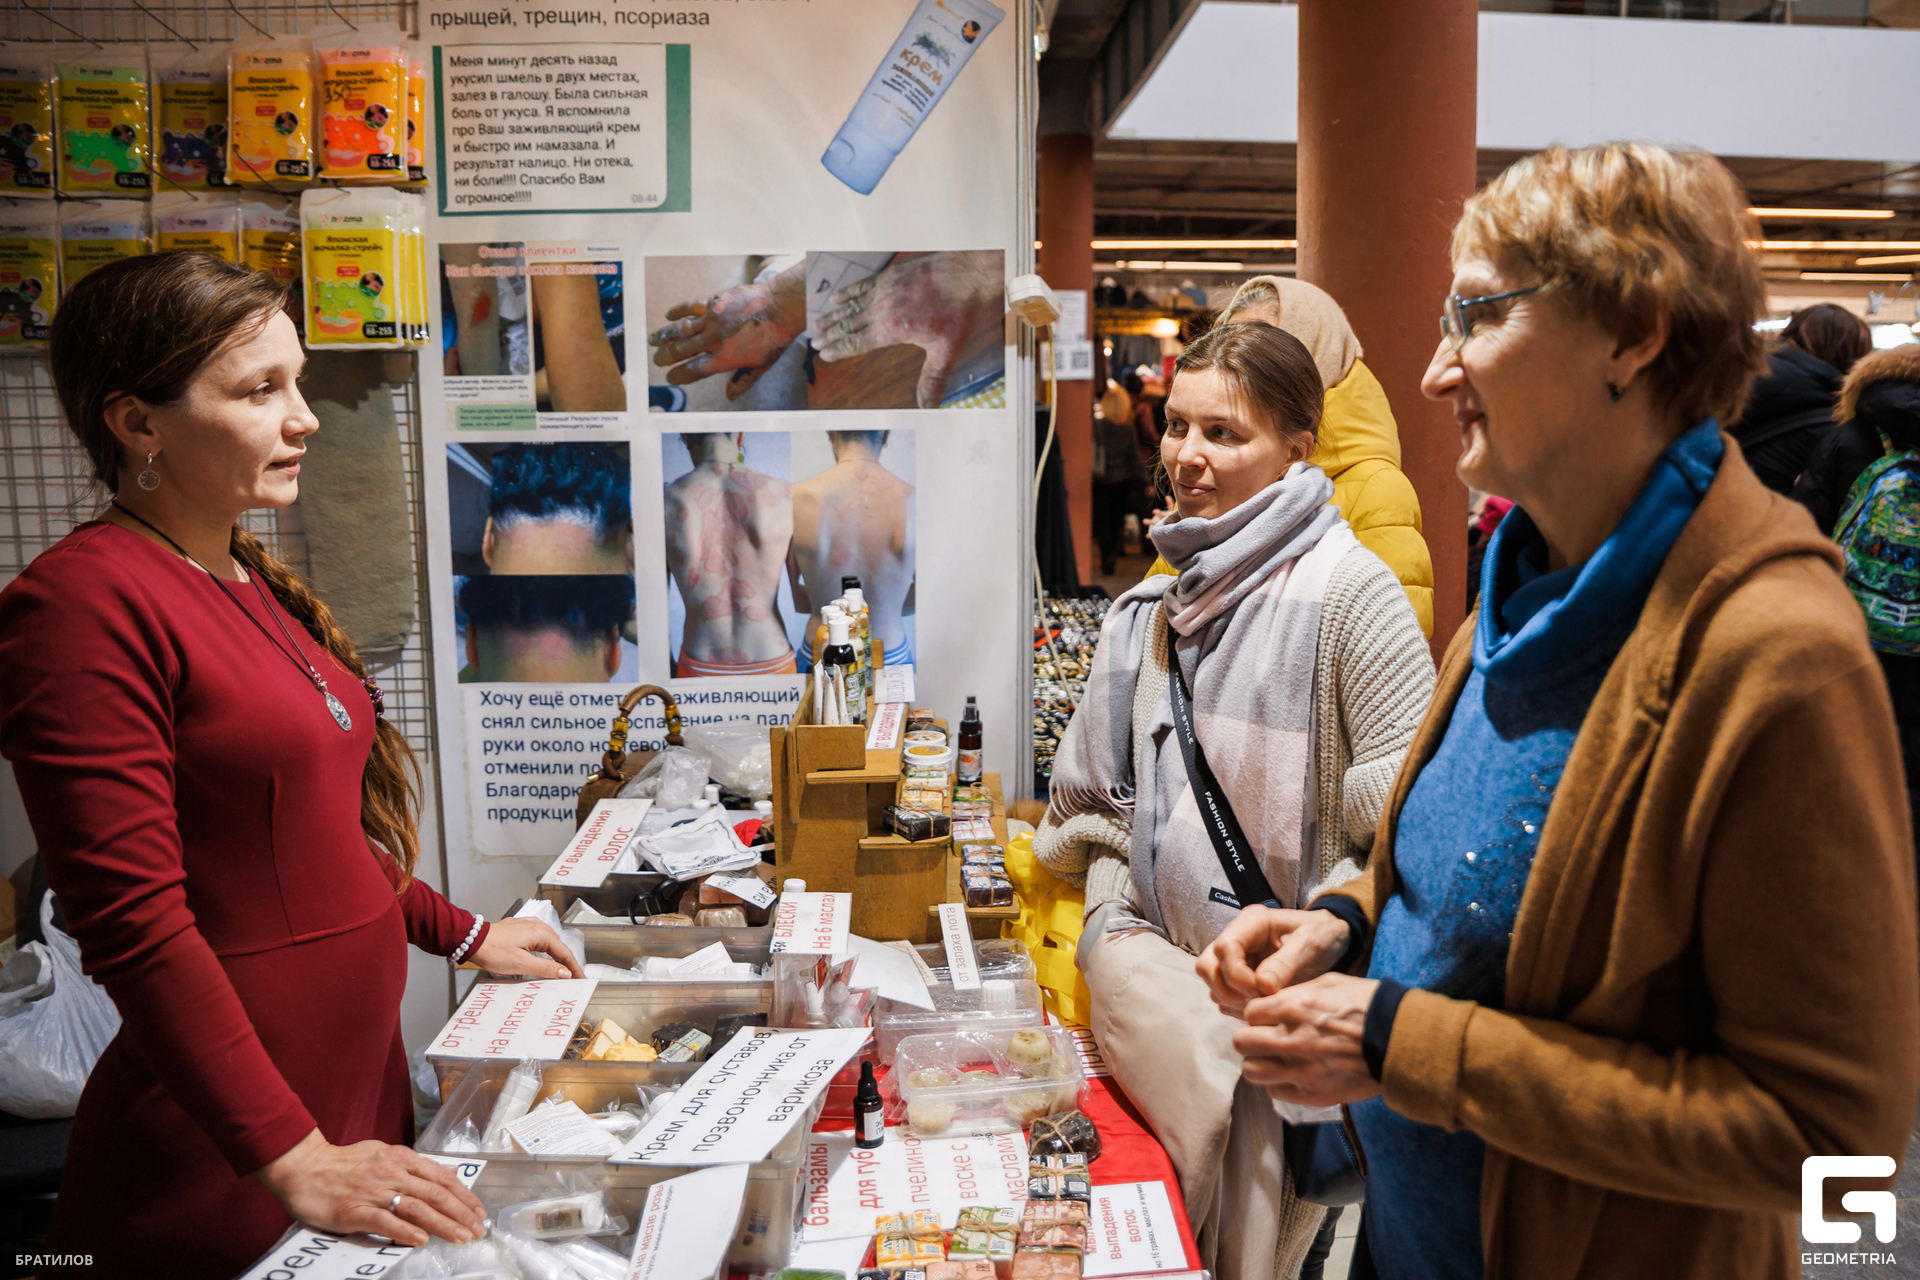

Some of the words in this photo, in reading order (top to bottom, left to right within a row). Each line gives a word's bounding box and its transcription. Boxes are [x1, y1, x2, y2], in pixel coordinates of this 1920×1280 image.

[431, 9, 517, 27] прыщей,
[524, 10, 607, 26] трещин,
[615, 11, 710, 28] псориаза
[450, 56, 483, 67] Меня
[487, 56, 527, 68] минут
[530, 54, 575, 67] десять
[579, 54, 617, 67] назад
[450, 73, 492, 85] укусил
[497, 72, 541, 84] шмель
[546, 73, 552, 82] в
[557, 71, 585, 85] двух
[589, 71, 640, 84] местах,
[451, 90, 486, 101] залез
[491, 90, 497, 99] в
[501, 90, 550, 102] галошу.
[555, 88, 589, 99] Была
[593, 88, 648, 99] сильная
[452, 106, 481, 118] боль
[485, 108, 498, 117] от
[502, 107, 541, 119] укуса.
[546, 106, 554, 116] Я
[557, 106, 630, 117] вспомнила
[453, 125, 475, 138] про
[478, 123, 504, 135] Ваш
[508, 122, 604, 135] заживляющий
[607, 123, 640, 135] крем
[453, 143, 460, 152] и
[465, 140, 510, 154] быстро
[514, 141, 532, 150] им
[536, 140, 602, 151] намазала.
[606, 139, 615, 149] И
[454, 159, 514, 172] результат
[518, 157, 569, 170] налицо.
[574, 156, 591, 167] Ни
[595, 156, 633, 168] отека,
[455, 177, 469, 187] ни
[520, 173, 575, 185] Спасибо
[579, 174, 605, 184] Вам
[631, 194, 657, 203] 08:44
[326, 235, 368, 243] Японская
[479, 245, 517, 258] Отзыв
[520, 247, 577, 257] клиентки
[446, 265, 469, 276] Как
[471, 263, 516, 278] быстро
[519, 264, 563, 276] зажила
[567, 264, 617, 274] коленка
[480, 691, 523, 709] Хочу
[529, 691, 564, 708] ещё
[570, 693, 656, 706] отметть
[664, 687, 800, 706] аживляющий
[481, 717, 524, 728] снял
[531, 718, 606, 729] сильное
[612, 713, 723, 729] оспаение
[757, 714, 797, 726] пал
[483, 740, 524, 755] руки
[531, 740, 584, 752] около
[590, 740, 672, 752] нотевой
[484, 763, 573, 774] отменили
[580, 764, 601, 774] по
[1204, 791, 1228, 838] FASHION
[1225, 839, 1245, 872] STYLE
[556, 865, 573, 876] от
[566, 810, 613, 863] выпадения
[822, 893, 836, 924] маслах
[774, 901, 798, 940] БЛЕСКИ
[946, 907, 959, 931] пота
[821, 926, 832, 934] 6
[812, 936, 831, 949] На
[951, 934, 966, 968] запаха
[959, 972, 970, 982] от
[441, 1031, 460, 1049] от
[455, 984, 500, 1031] трещин
[485, 1037, 507, 1054] на
[497, 993, 534, 1037] пятках
[526, 982, 544, 991] и
[543, 999, 578, 1037] руках
[628, 1119, 688, 1160] Крем
[681, 1088, 716, 1116] для
[709, 1028, 780, 1085] суставов,
[692, 1051, 796, 1152] позвоночника
[789, 1036, 812, 1050] от
[848, 1150, 881, 1175] губ
[995, 1132, 1028, 1202] маслами
[802, 1143, 830, 1226] бальзамы
[953, 1155, 979, 1199] воске
[650, 1184, 665, 1212] розы
[858, 1179, 884, 1209] для
[1142, 1206, 1152, 1228] маслах
[640, 1214, 657, 1251] масле
[1098, 1196, 1122, 1260] выпадения
[635, 1253, 647, 1268] на
[1155, 1260, 1163, 1268] на
